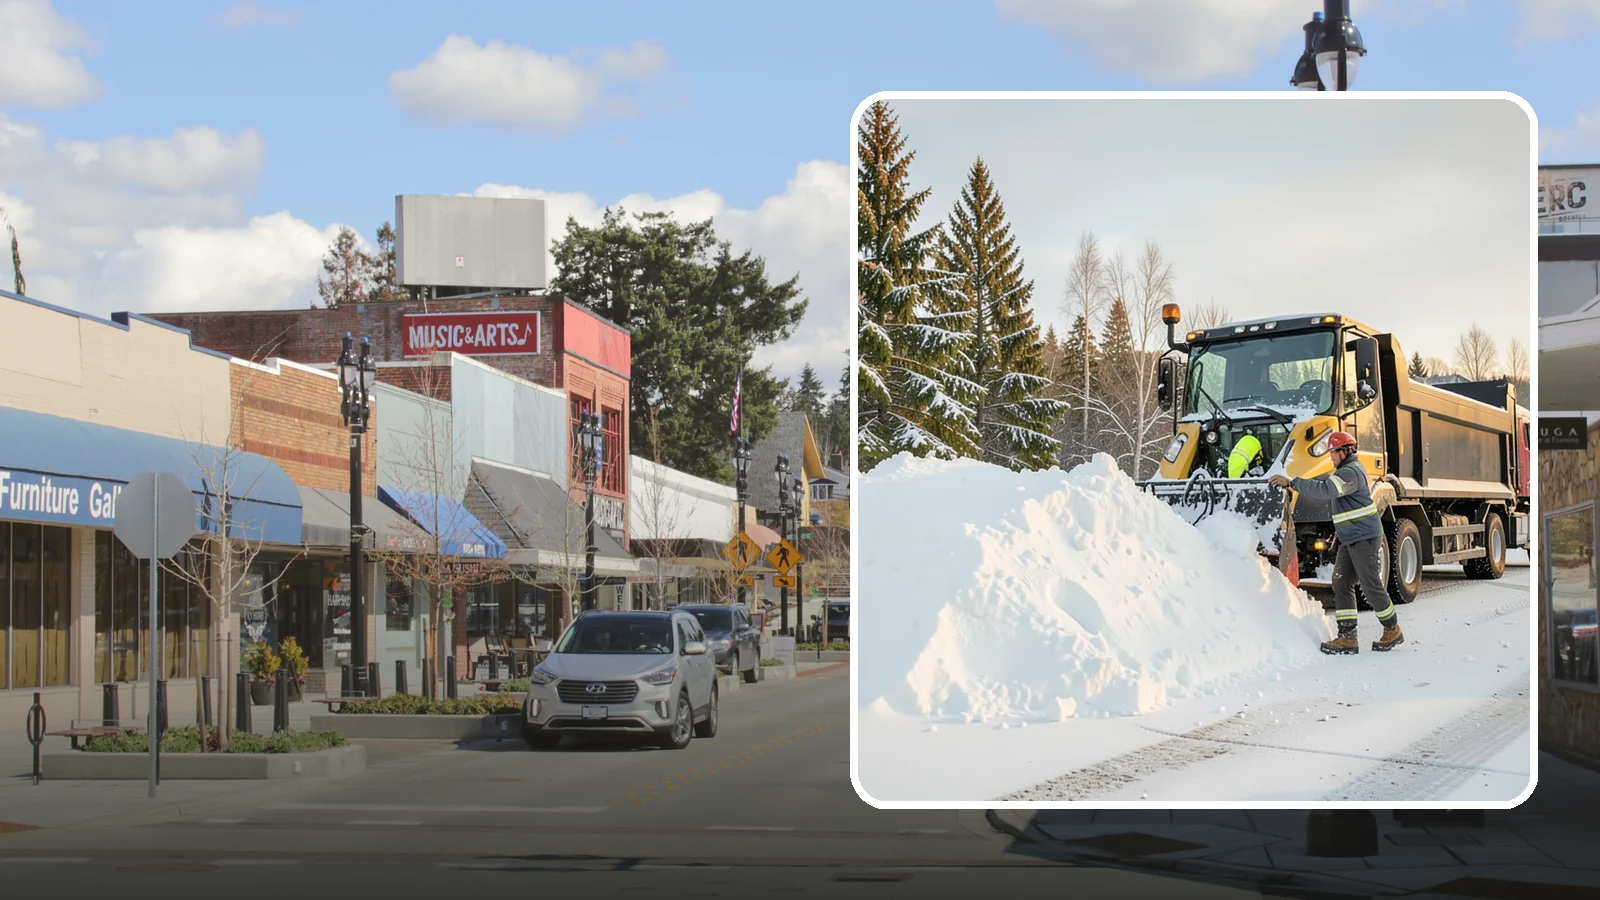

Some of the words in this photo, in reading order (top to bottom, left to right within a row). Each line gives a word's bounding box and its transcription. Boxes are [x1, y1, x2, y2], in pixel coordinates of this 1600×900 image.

[409, 323, 519, 348] MUSIC&ARTS
[1540, 427, 1577, 436] UGA
[0, 471, 79, 515] Furniture
[453, 563, 479, 574] SUSHI
